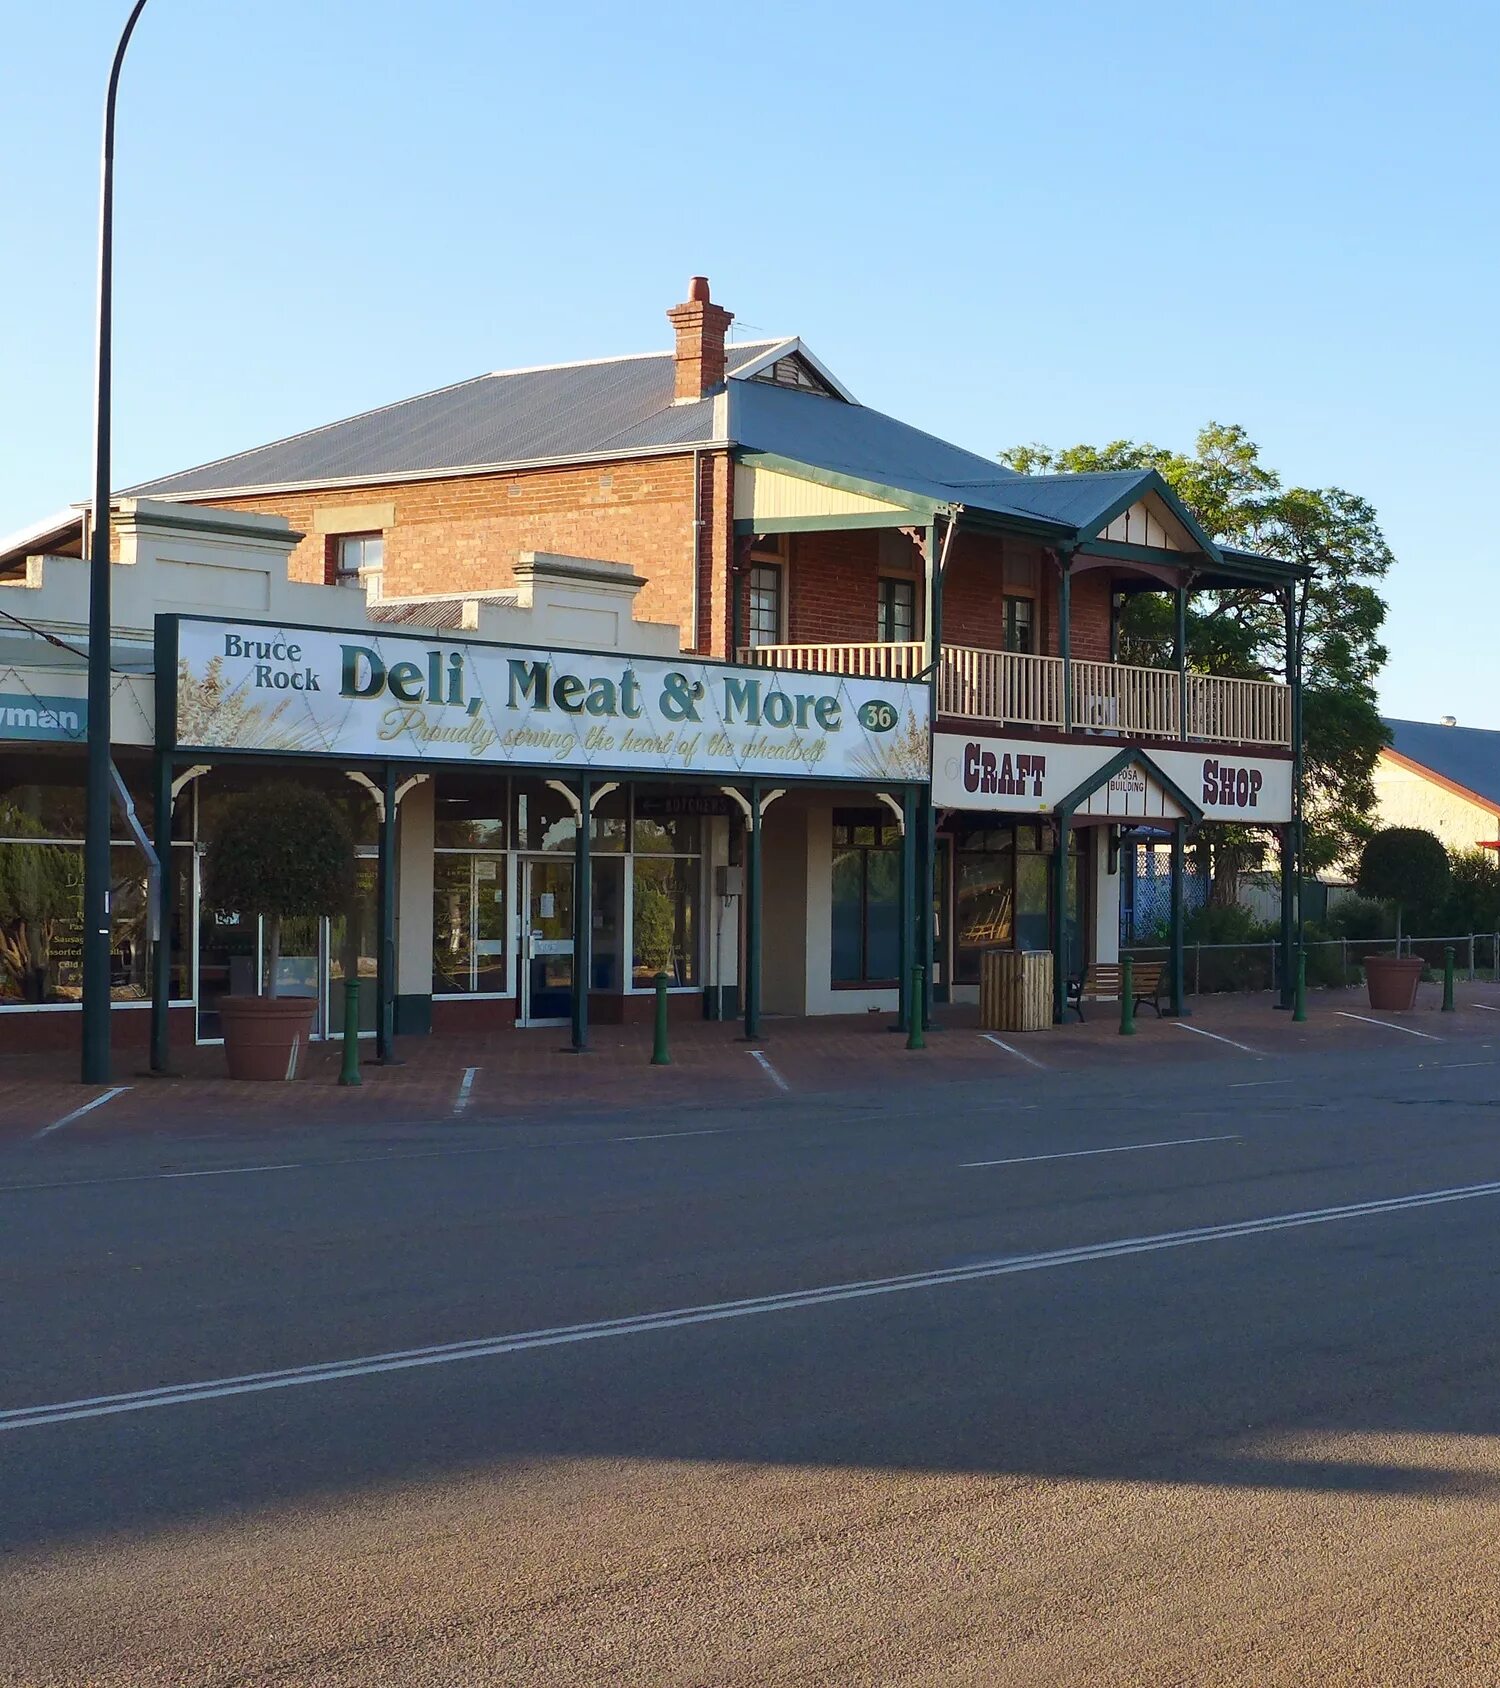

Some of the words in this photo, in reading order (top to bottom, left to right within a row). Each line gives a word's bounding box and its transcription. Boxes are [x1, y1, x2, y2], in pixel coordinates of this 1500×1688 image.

[224, 633, 302, 662] Bruce
[255, 664, 321, 692] Rock
[338, 644, 484, 717] Deli,
[505, 658, 643, 720] Meat
[658, 672, 705, 723] &
[723, 677, 843, 732] More
[866, 705, 891, 728] 36
[378, 706, 496, 756] Proudly
[502, 726, 577, 761] serving
[584, 725, 615, 751] the
[619, 728, 675, 755] heart
[677, 731, 703, 768] of
[707, 731, 735, 758] the
[740, 735, 827, 763] wheatbelt
[963, 742, 1046, 797] CRAFT
[1110, 780, 1144, 792] BUILDING
[1202, 758, 1263, 808] SHOP
